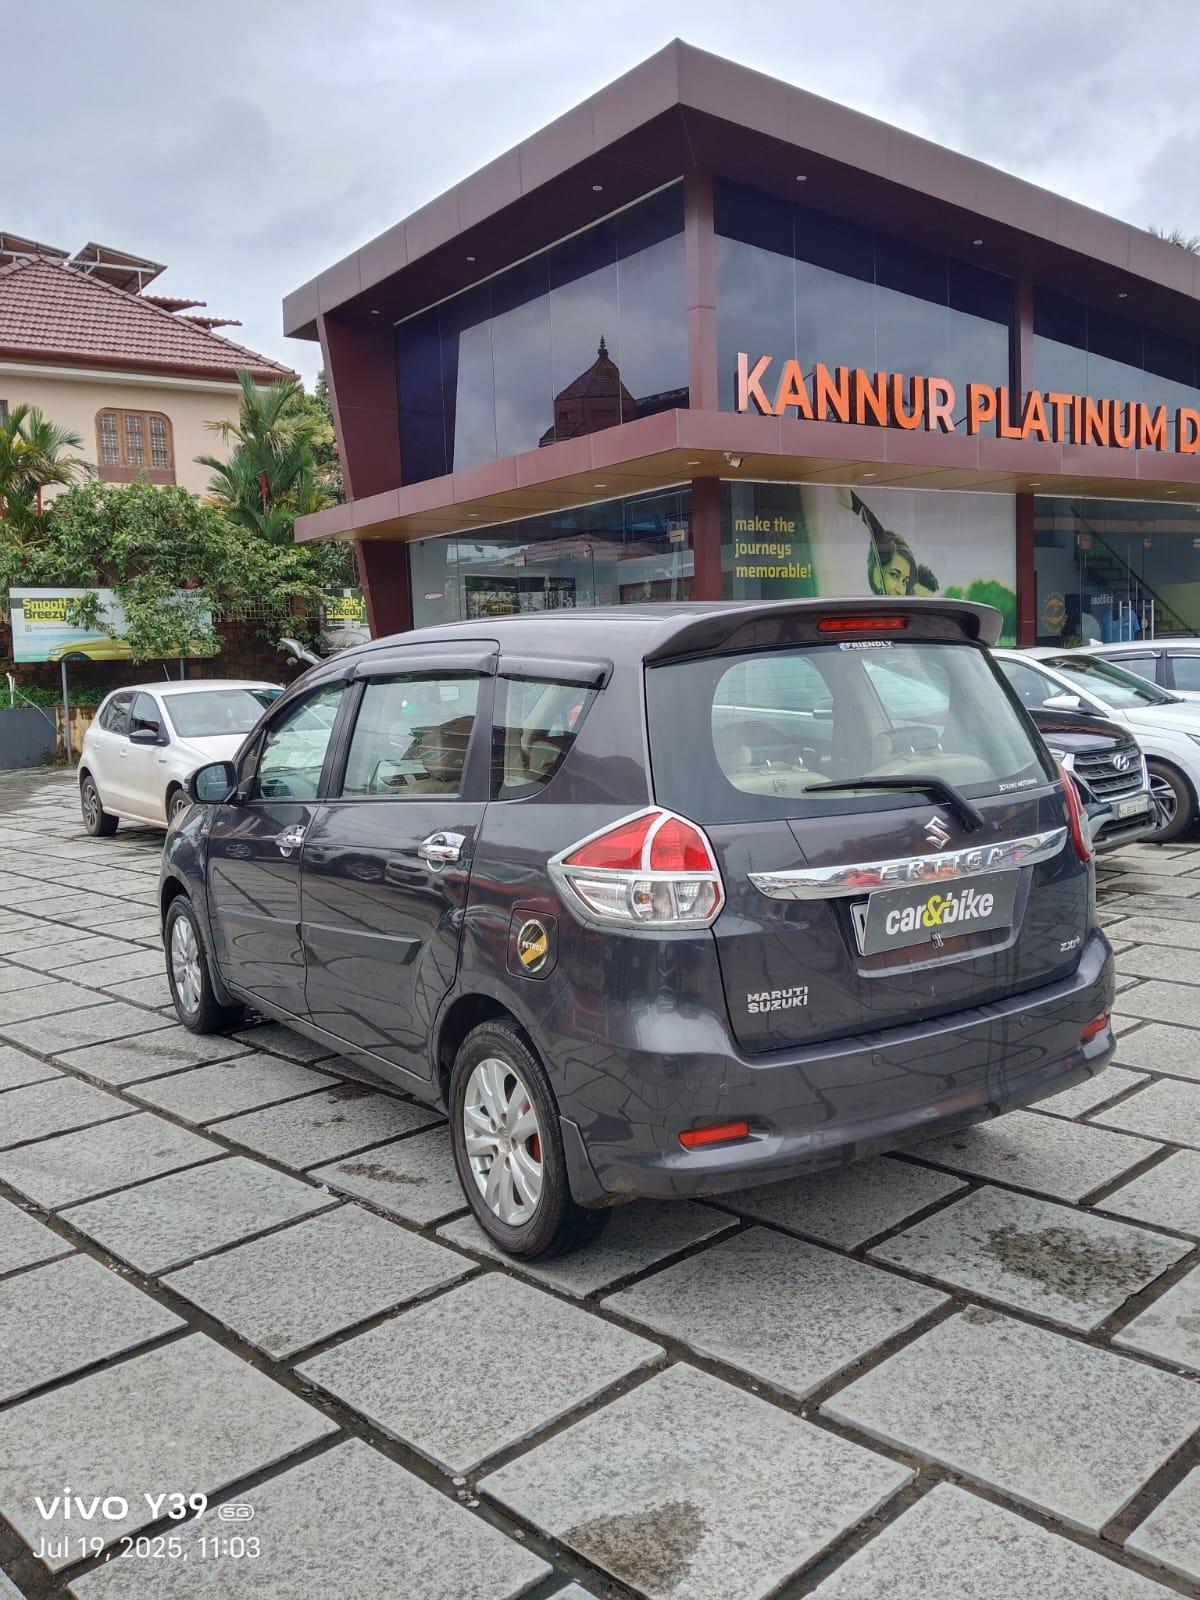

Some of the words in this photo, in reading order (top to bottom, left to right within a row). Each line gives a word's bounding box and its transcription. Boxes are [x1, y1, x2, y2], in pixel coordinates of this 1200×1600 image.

[736, 352, 957, 433] KANNUR
[967, 383, 1168, 450] PLATINUM
[735, 517, 771, 533] make
[774, 517, 795, 533] the
[735, 541, 792, 559] journeys
[735, 563, 812, 580] memorable!
[23, 609, 67, 621] Breezy
[880, 847, 1003, 880] ERTIGA
[885, 888, 994, 936] car&bike
[522, 941, 545, 952] PETROL
[747, 986, 809, 1004] MARUTI
[747, 995, 808, 1014] SUZUKI
